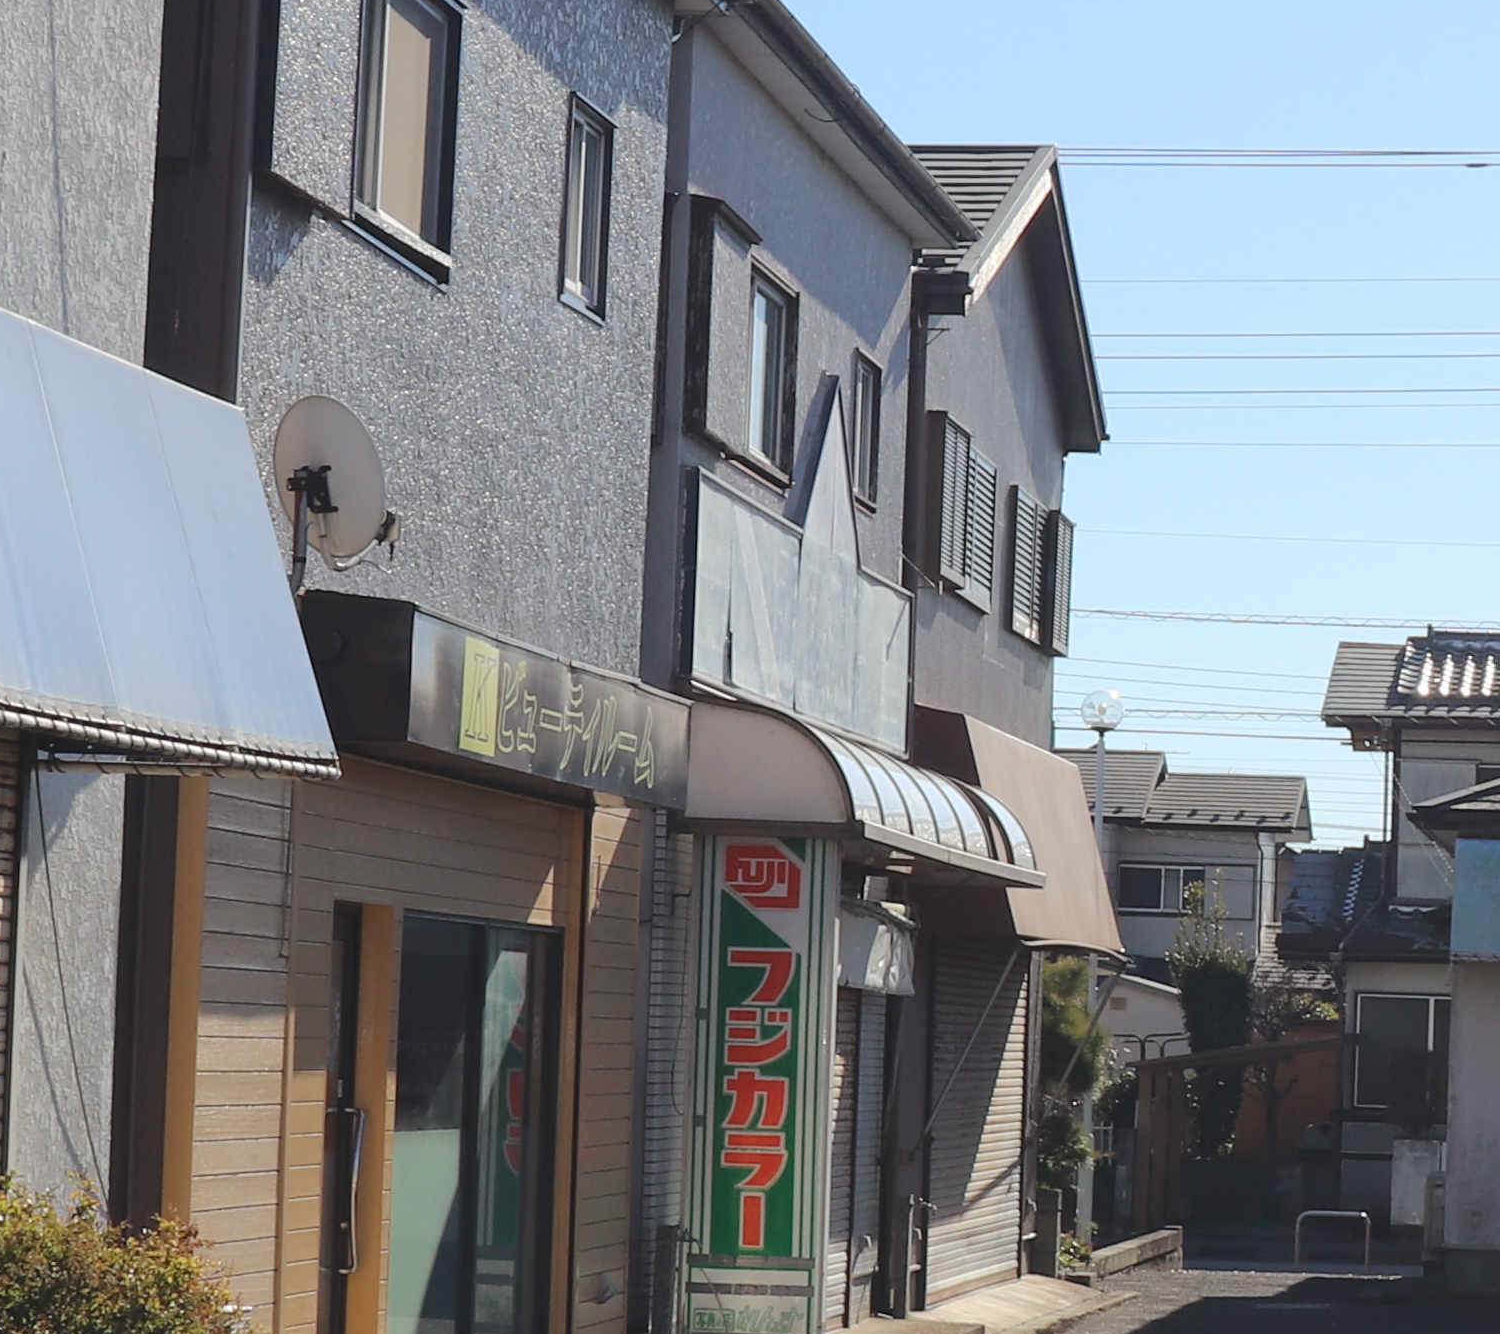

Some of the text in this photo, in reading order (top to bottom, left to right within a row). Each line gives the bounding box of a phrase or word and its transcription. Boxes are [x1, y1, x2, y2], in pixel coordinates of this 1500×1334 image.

[721, 946, 796, 1251] フジカラー
